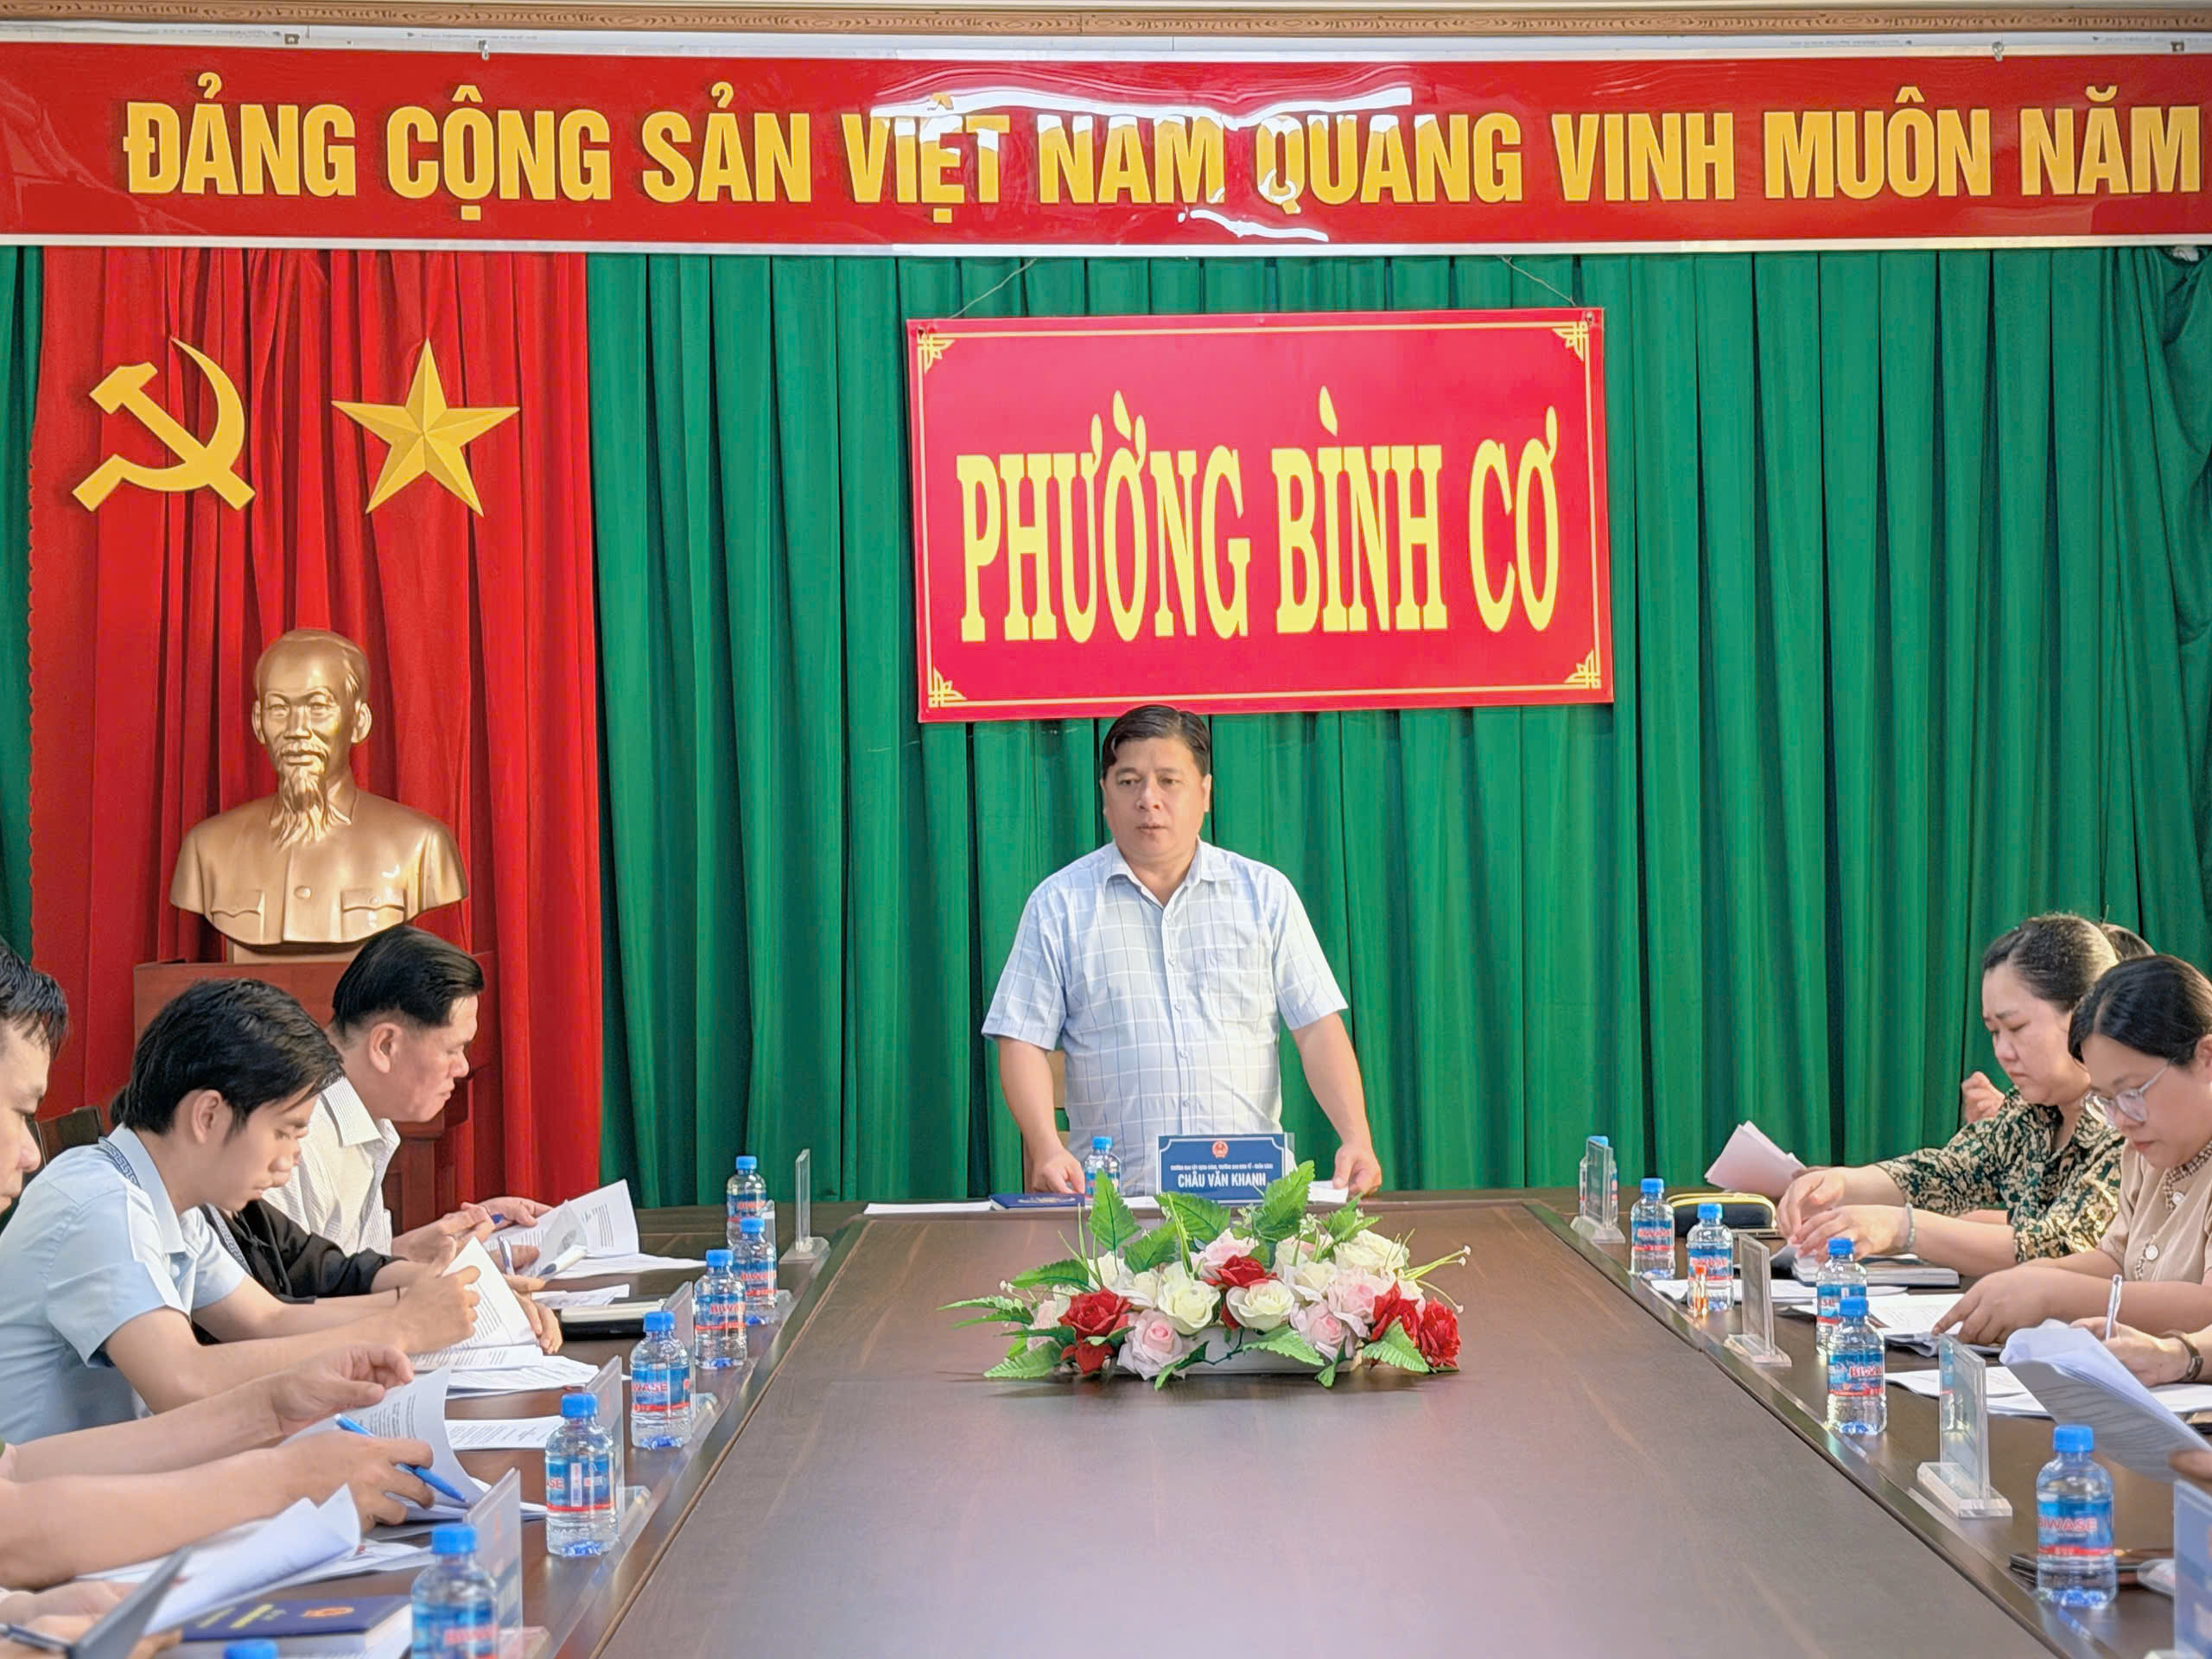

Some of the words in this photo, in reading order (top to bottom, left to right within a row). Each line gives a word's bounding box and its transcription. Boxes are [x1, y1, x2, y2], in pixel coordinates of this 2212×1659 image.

[123, 71, 356, 197] ĐẢNG
[386, 84, 611, 221] CỘNG
[641, 81, 811, 203] SẢN
[842, 92, 1010, 224] VIỆT
[1038, 113, 1225, 204] NAM
[1255, 113, 1522, 214] QUANG
[1551, 112, 1736, 201] VINH
[1764, 85, 1992, 200] MUÔN
[2020, 85, 2201, 196] NĂM
[957, 389, 1251, 644] PHƯỜNG
[1272, 385, 1448, 633] BÌNH
[1469, 405, 1560, 632] CƠ
[1178, 1169, 1205, 1188] CHÂU
[1208, 1169, 1229, 1187] VĂN
[1231, 1172, 1266, 1186] KHANH
[2037, 1516, 2098, 1533] BIWASE
